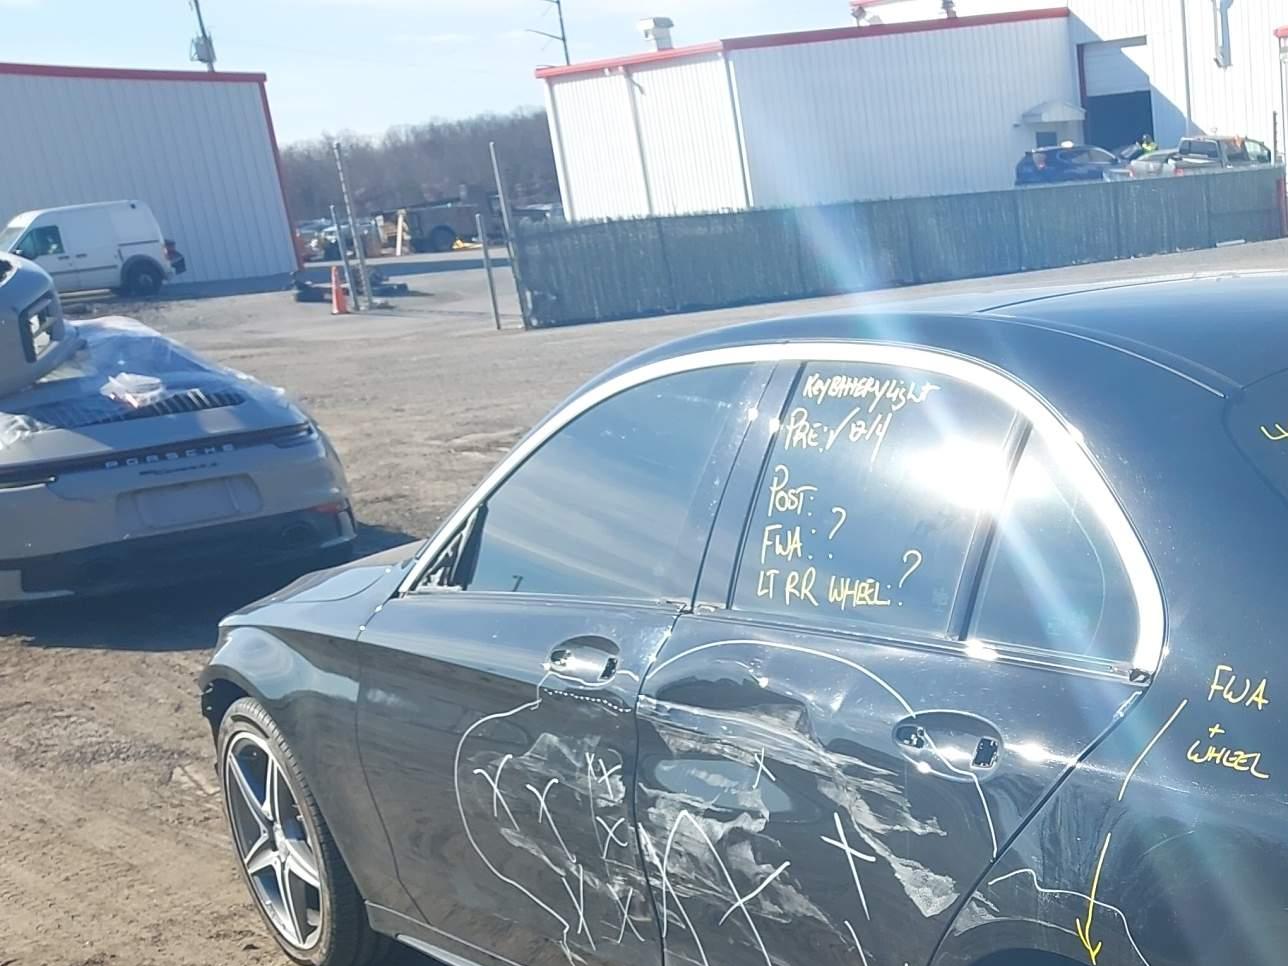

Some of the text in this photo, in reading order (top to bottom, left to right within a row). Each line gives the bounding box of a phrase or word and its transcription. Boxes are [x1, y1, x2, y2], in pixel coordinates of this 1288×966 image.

[104, 442, 235, 469] PORSCHE
[757, 569, 780, 600] LT
[785, 566, 819, 608] RR
[1207, 664, 1270, 711] FWA
[1186, 740, 1271, 780] WHEEL
